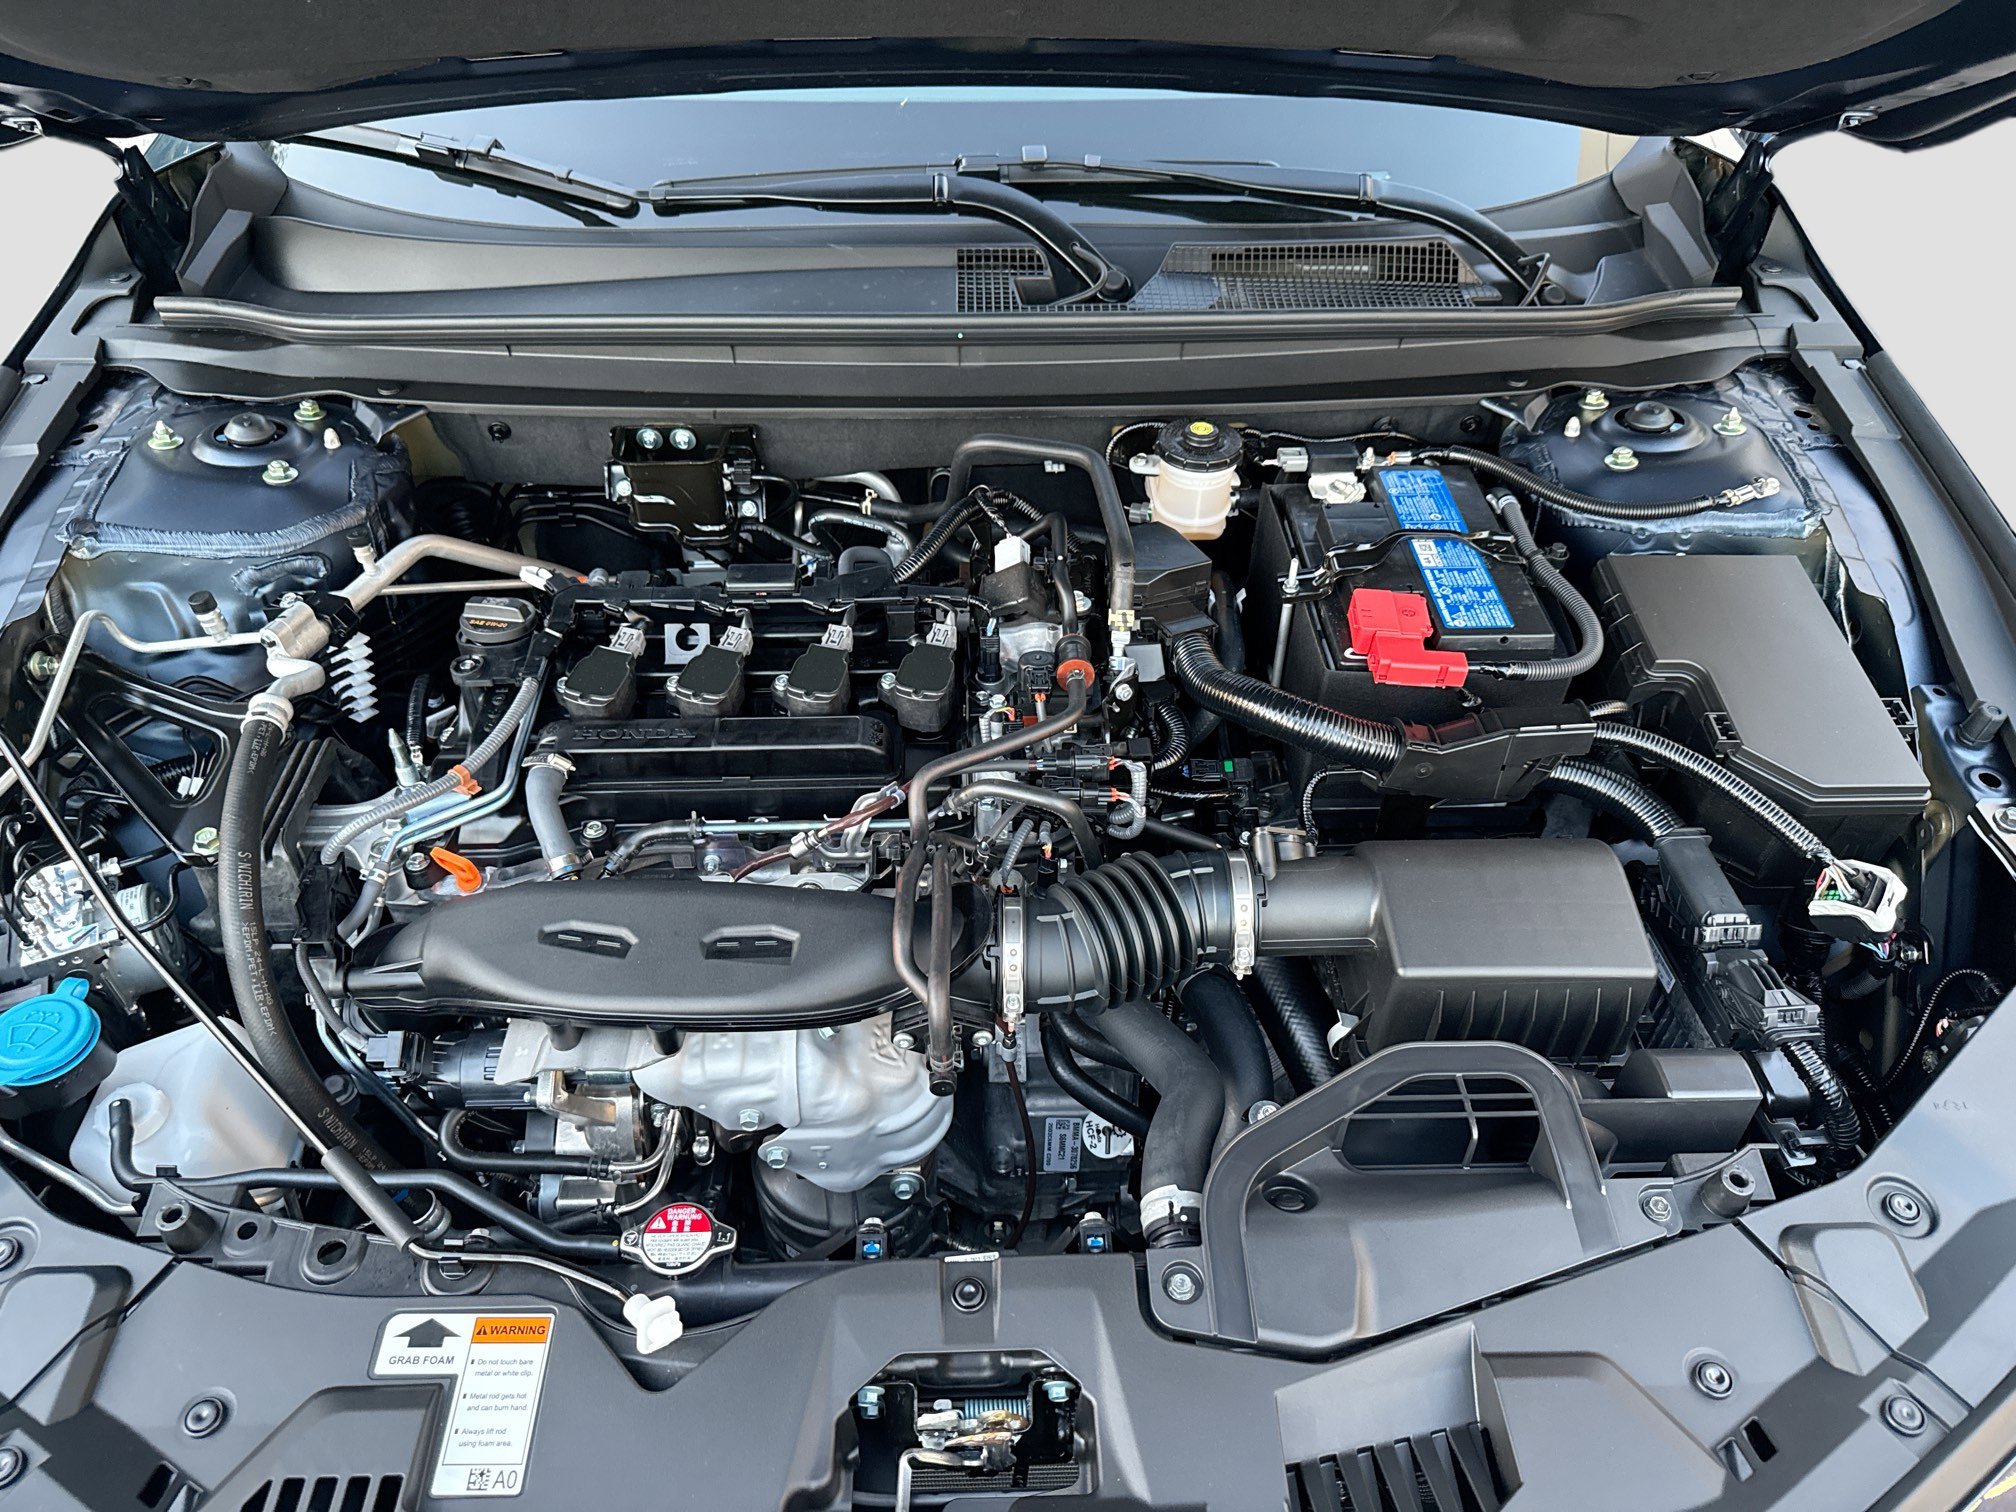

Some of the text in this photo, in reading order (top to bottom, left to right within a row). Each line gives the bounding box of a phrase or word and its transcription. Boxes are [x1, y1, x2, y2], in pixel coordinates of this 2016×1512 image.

[572, 728, 696, 740] HONDA
[1085, 1120, 1097, 1149] HCF-2
[717, 1232, 731, 1241] 1.1
[490, 1326, 546, 1335] WARNING
[389, 1356, 455, 1365] GRAB FOAM
[520, 1370, 533, 1378] clip.
[461, 1428, 485, 1436] Always
[458, 1440, 477, 1448] using
[492, 1470, 518, 1489] A0
